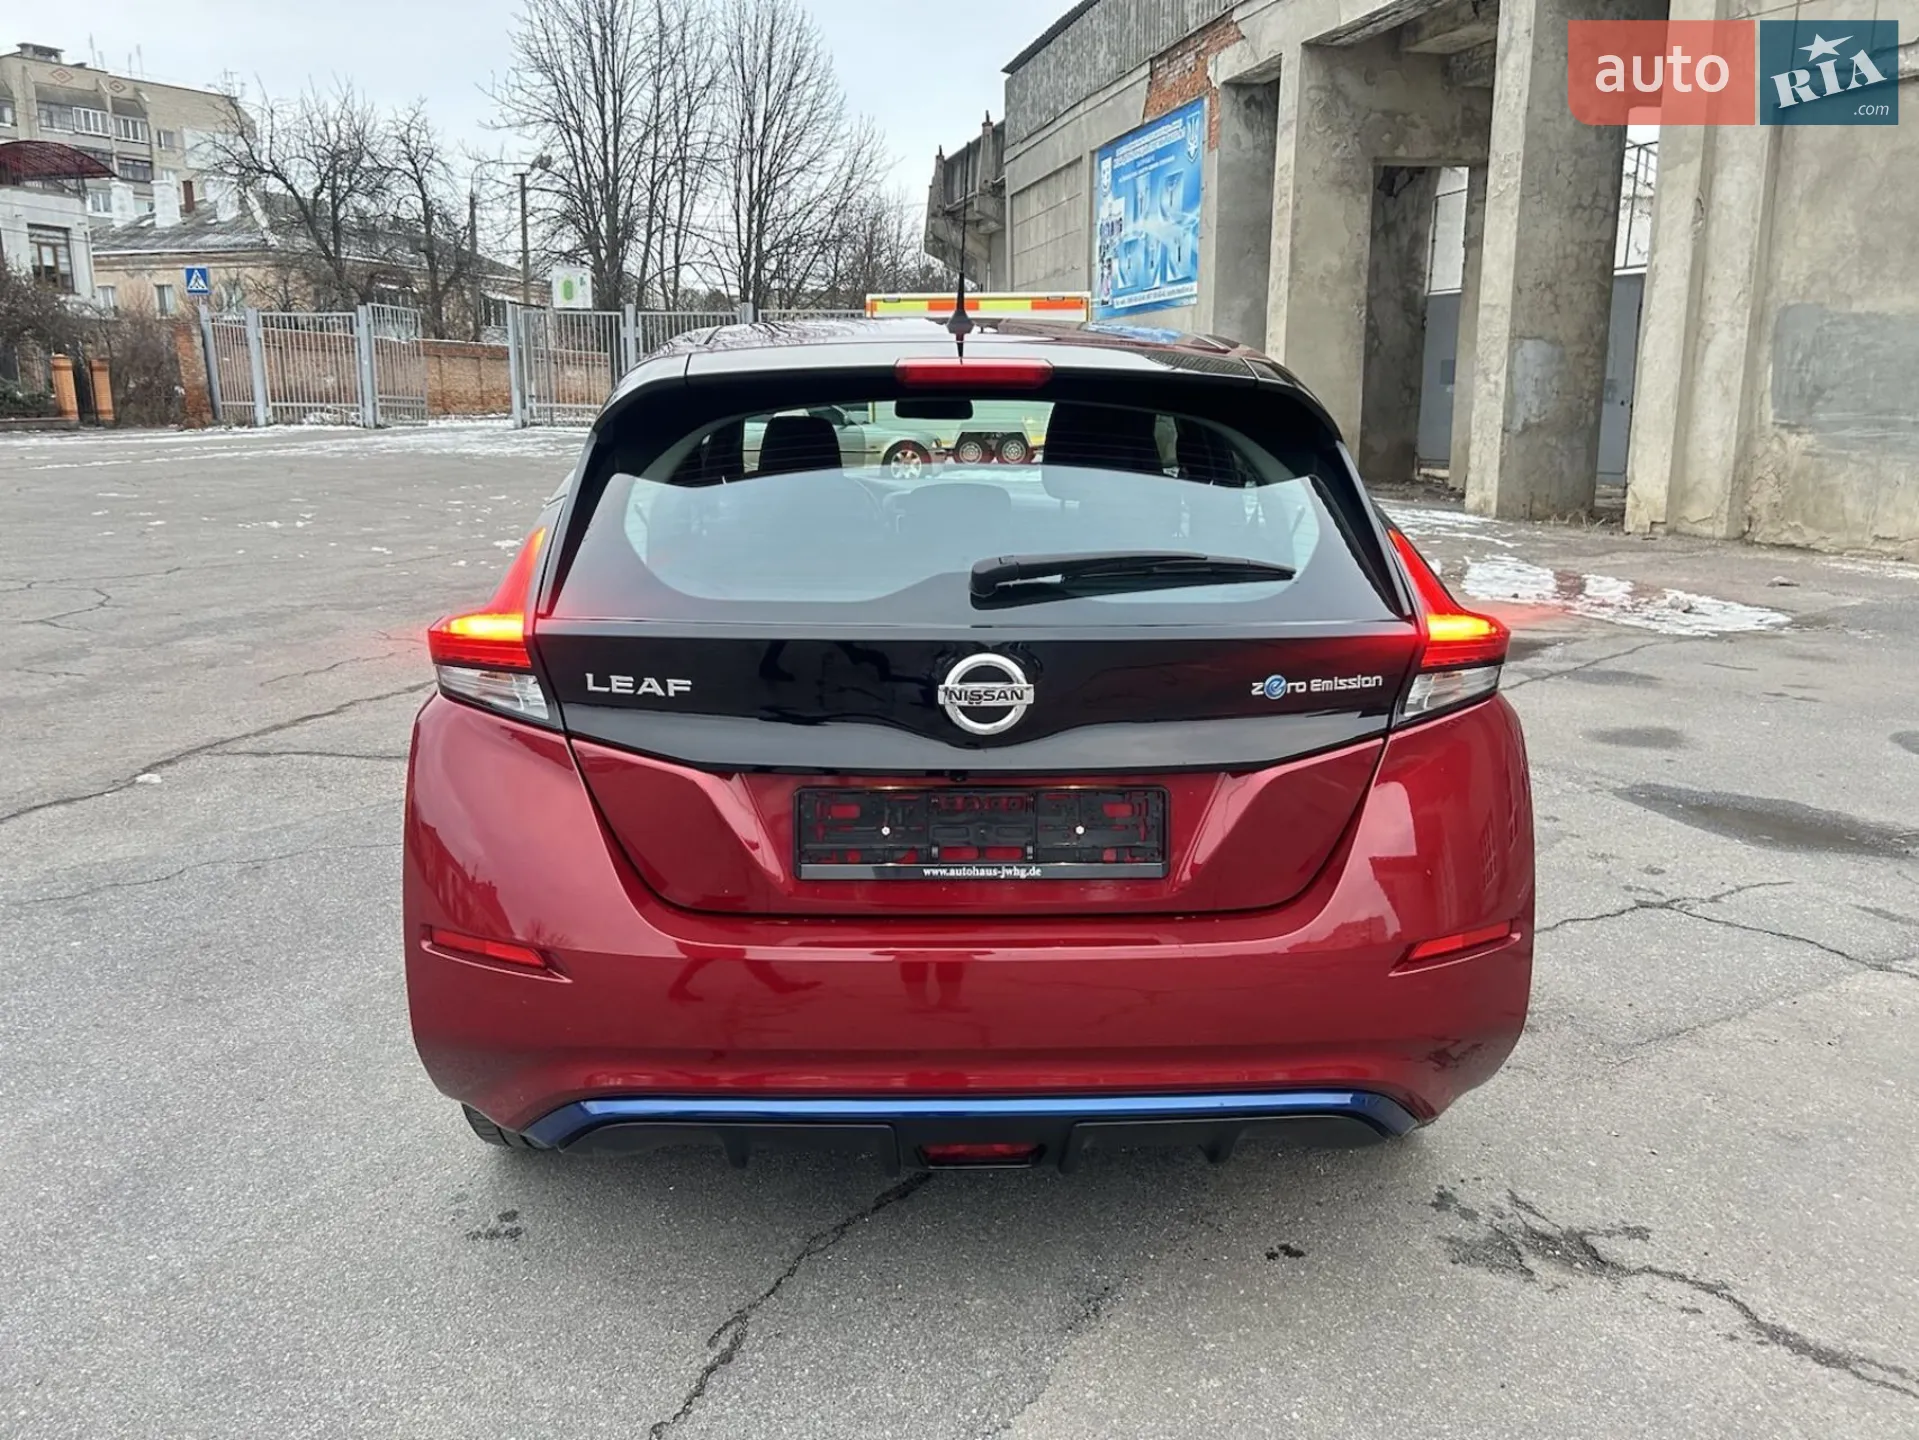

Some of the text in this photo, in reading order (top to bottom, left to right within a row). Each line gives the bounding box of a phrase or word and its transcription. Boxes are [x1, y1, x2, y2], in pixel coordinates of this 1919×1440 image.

[585, 673, 693, 697] LEAF
[1310, 674, 1383, 692] Emission
[948, 689, 1024, 701] NISSAN
[923, 866, 1042, 879] www.autohaus-jwhg.de
